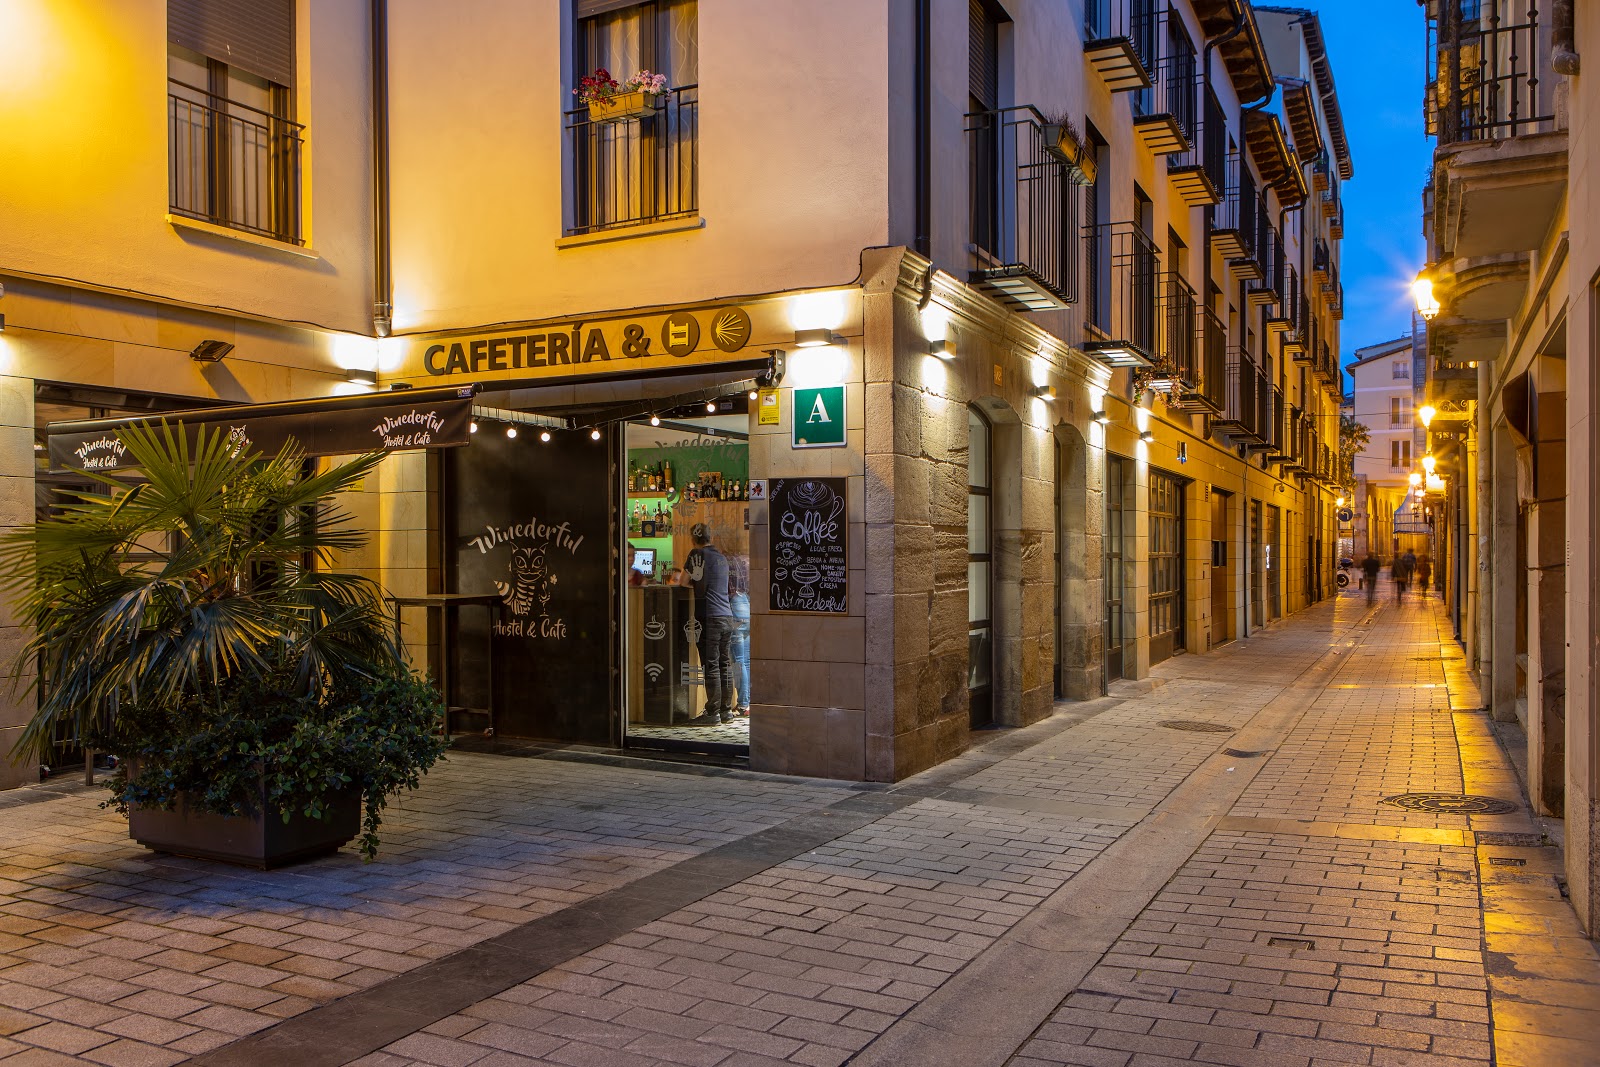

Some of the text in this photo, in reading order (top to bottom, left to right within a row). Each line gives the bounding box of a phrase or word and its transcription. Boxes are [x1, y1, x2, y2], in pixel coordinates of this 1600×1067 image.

[424, 322, 652, 376] CAFETERÍA &
[806, 393, 832, 424] A
[372, 409, 445, 437] Winederful
[74, 436, 127, 459] Winederful
[383, 434, 404, 448] Hostel
[404, 434, 412, 446] &
[83, 457, 98, 469] Hostel
[467, 516, 584, 555] Winederful
[693, 523, 703, 537] &
[781, 509, 839, 545] Coffee
[493, 618, 567, 640] Hostel & Café
